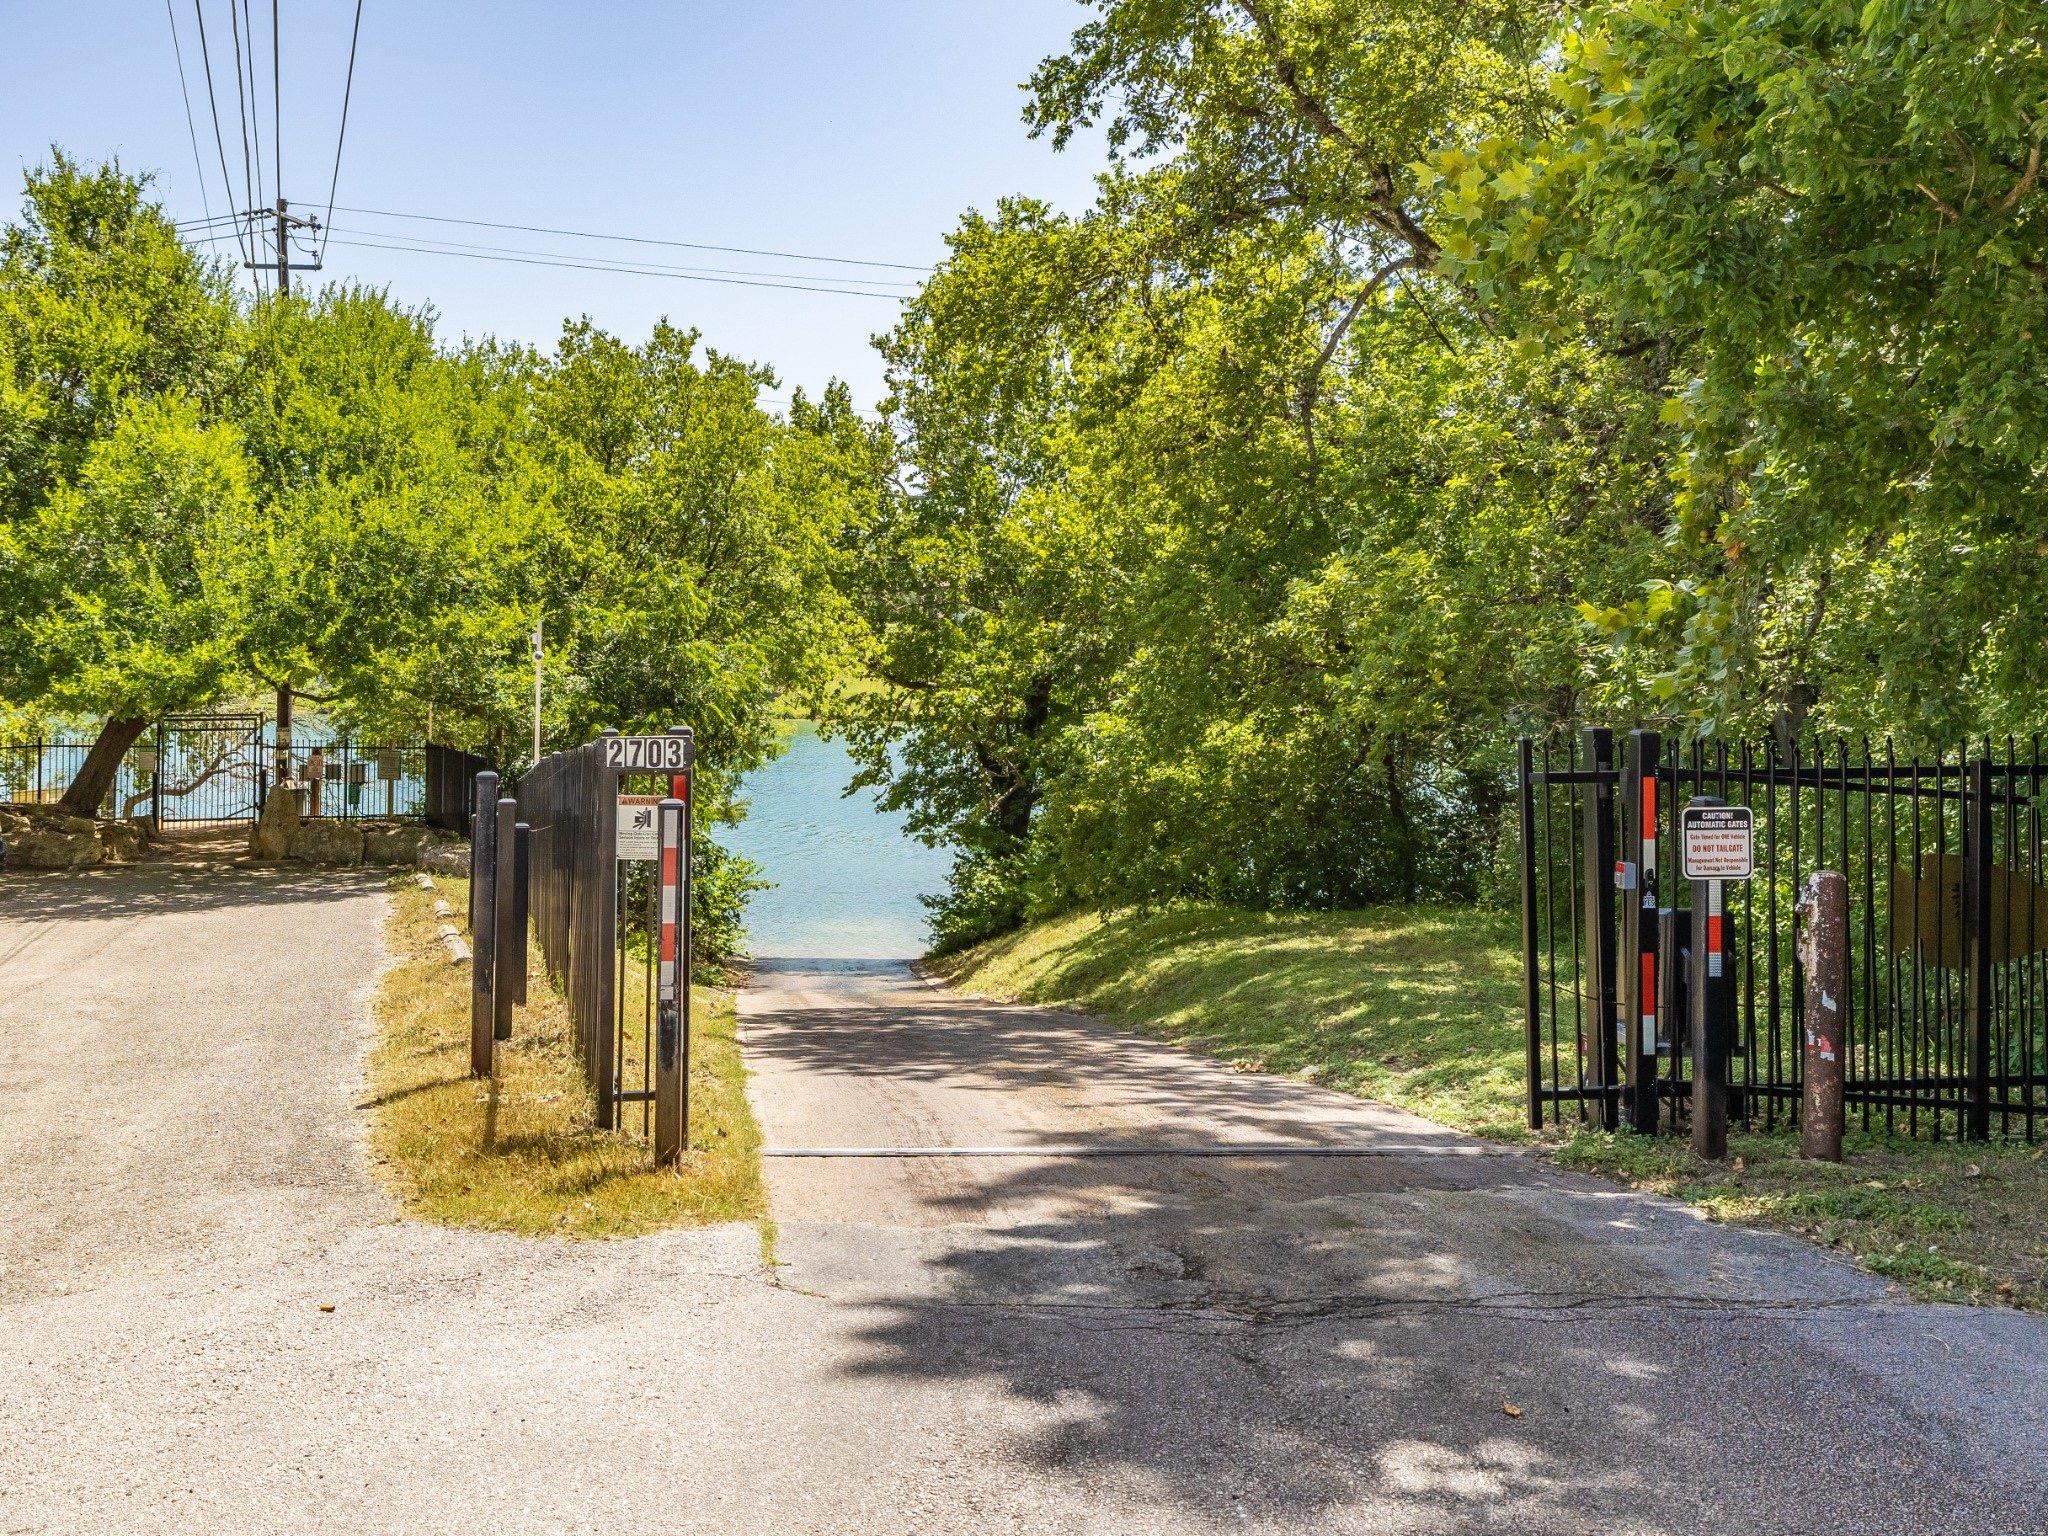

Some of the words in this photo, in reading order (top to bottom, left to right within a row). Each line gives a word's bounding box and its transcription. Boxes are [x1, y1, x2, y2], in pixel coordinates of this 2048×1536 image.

[608, 739, 682, 768] 2703
[628, 797, 660, 805] WARNIN
[1702, 812, 1734, 820] CAUTION!
[1687, 820, 1726, 828] AUTOMATIC
[1727, 820, 1748, 828] GATES
[1692, 844, 1701, 852] DO
[1702, 844, 1714, 852] NOT
[1716, 844, 1743, 852] TAILGATE
